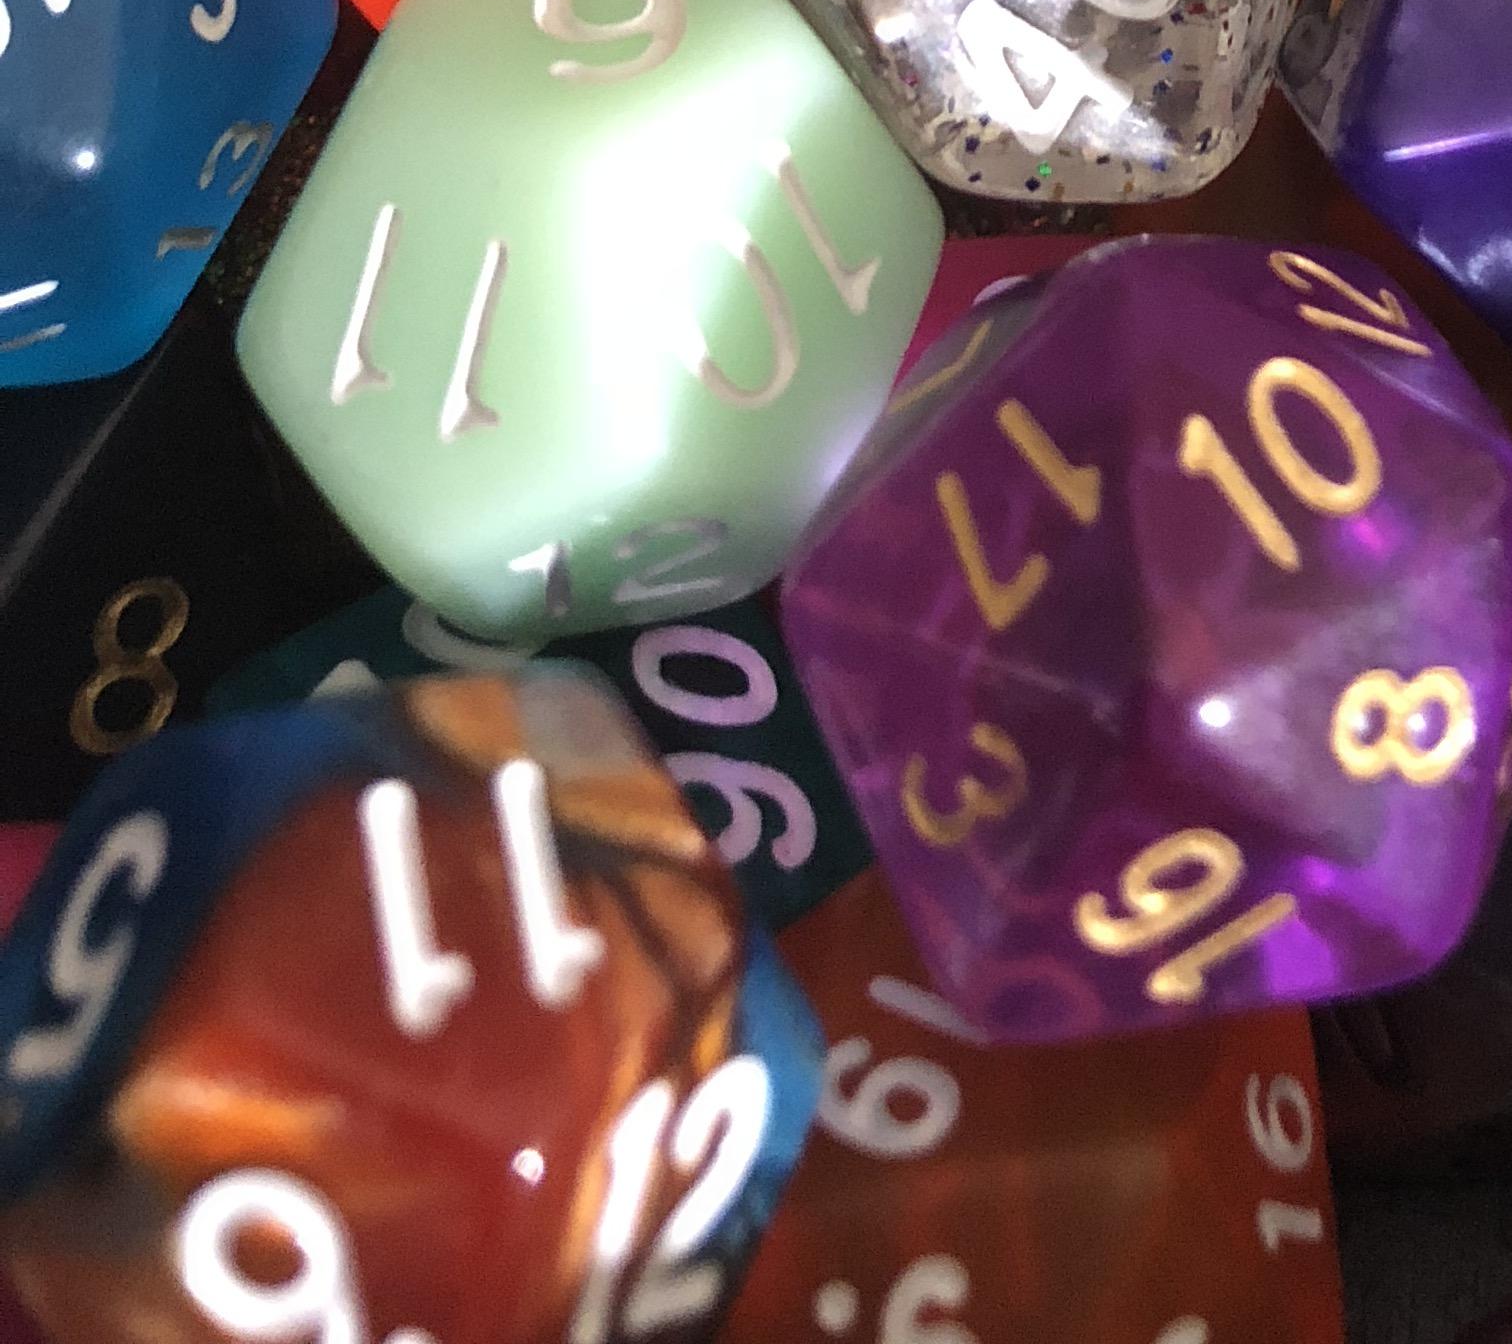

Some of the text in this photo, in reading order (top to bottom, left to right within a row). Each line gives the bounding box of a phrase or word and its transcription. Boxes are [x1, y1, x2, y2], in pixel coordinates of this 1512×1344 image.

[332, 202, 510, 444] 11
[935, 399, 1102, 632] 17
[1178, 355, 1383, 575] 10
[70, 577, 190, 755] 8
[1330, 665, 1478, 787] 8
[355, 755, 610, 1040] 11
[900, 722, 1030, 849] 3
[8, 807, 172, 1084] 5
[568, 1052, 776, 1344] 12
